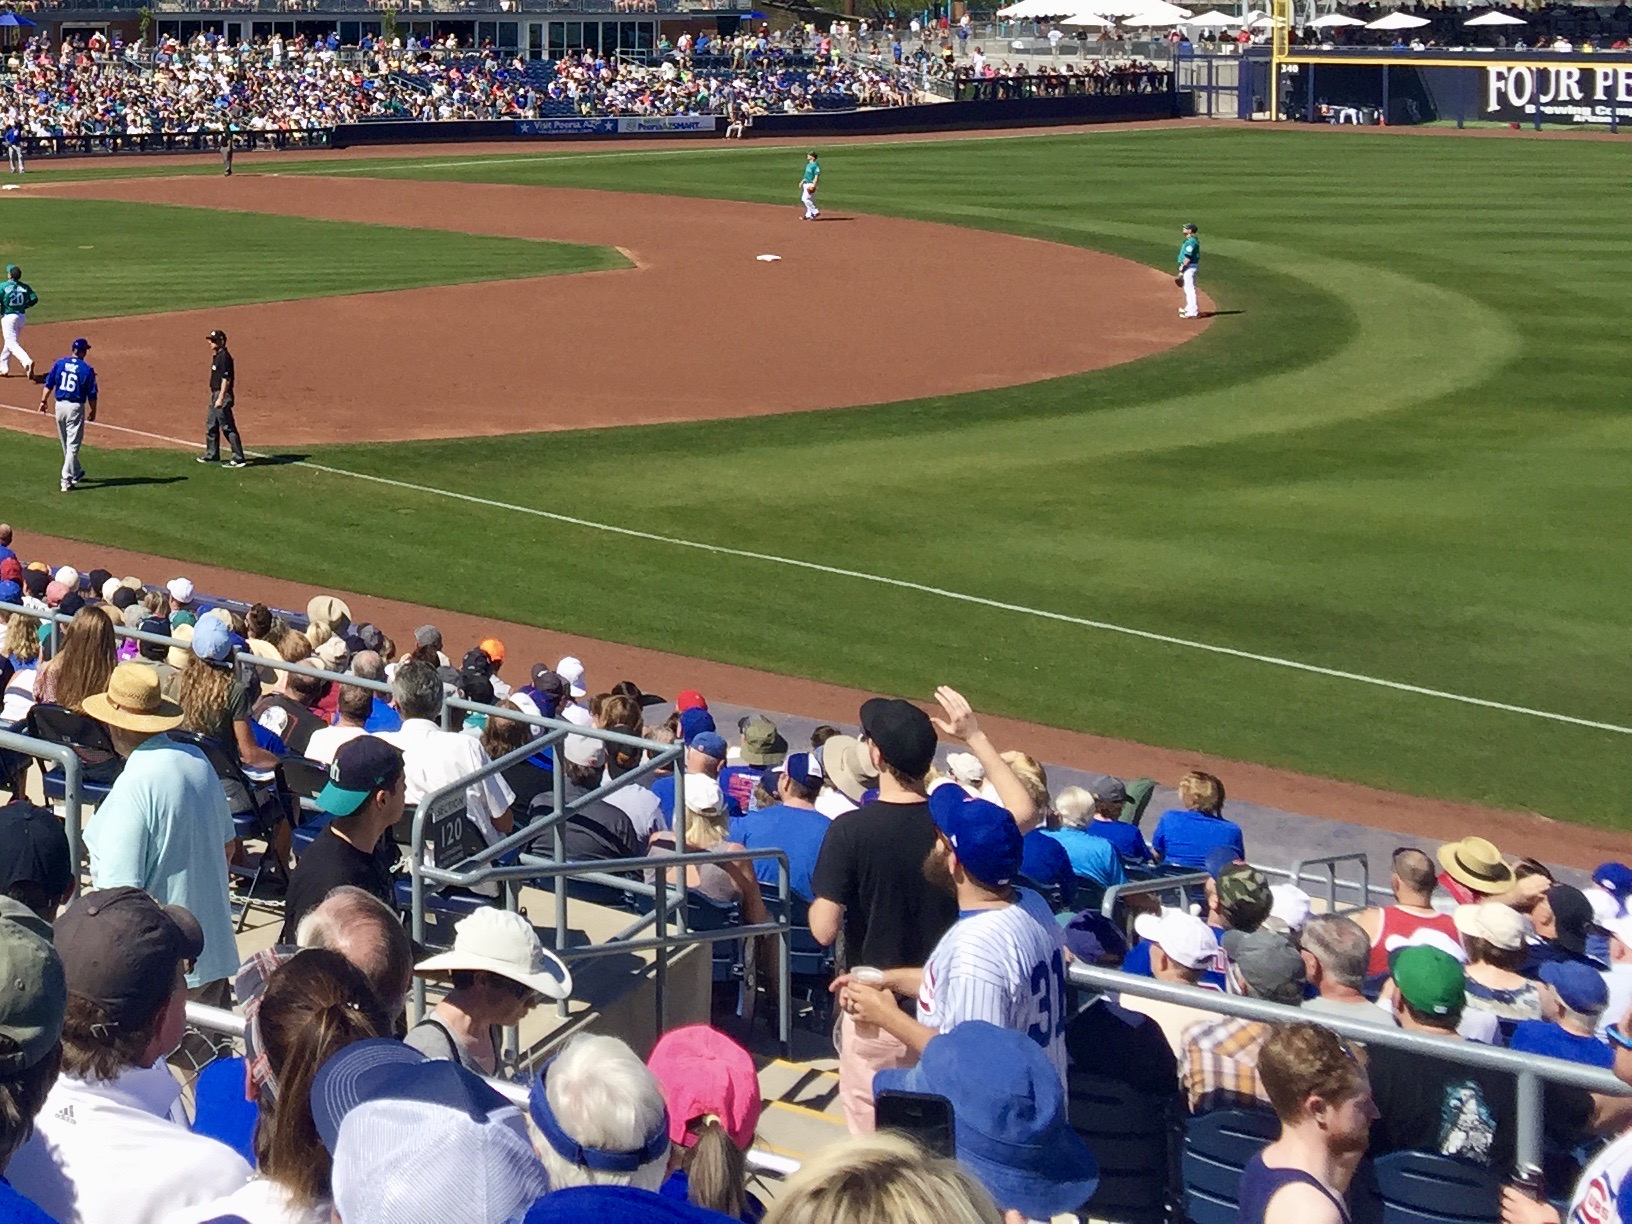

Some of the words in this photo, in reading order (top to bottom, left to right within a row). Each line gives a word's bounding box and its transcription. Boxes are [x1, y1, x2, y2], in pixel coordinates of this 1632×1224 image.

[1280, 64, 1299, 73] 340
[1486, 66, 1584, 113] FOUR
[9, 292, 24, 306] 20
[59, 371, 78, 393] 16
[441, 817, 463, 848] 120
